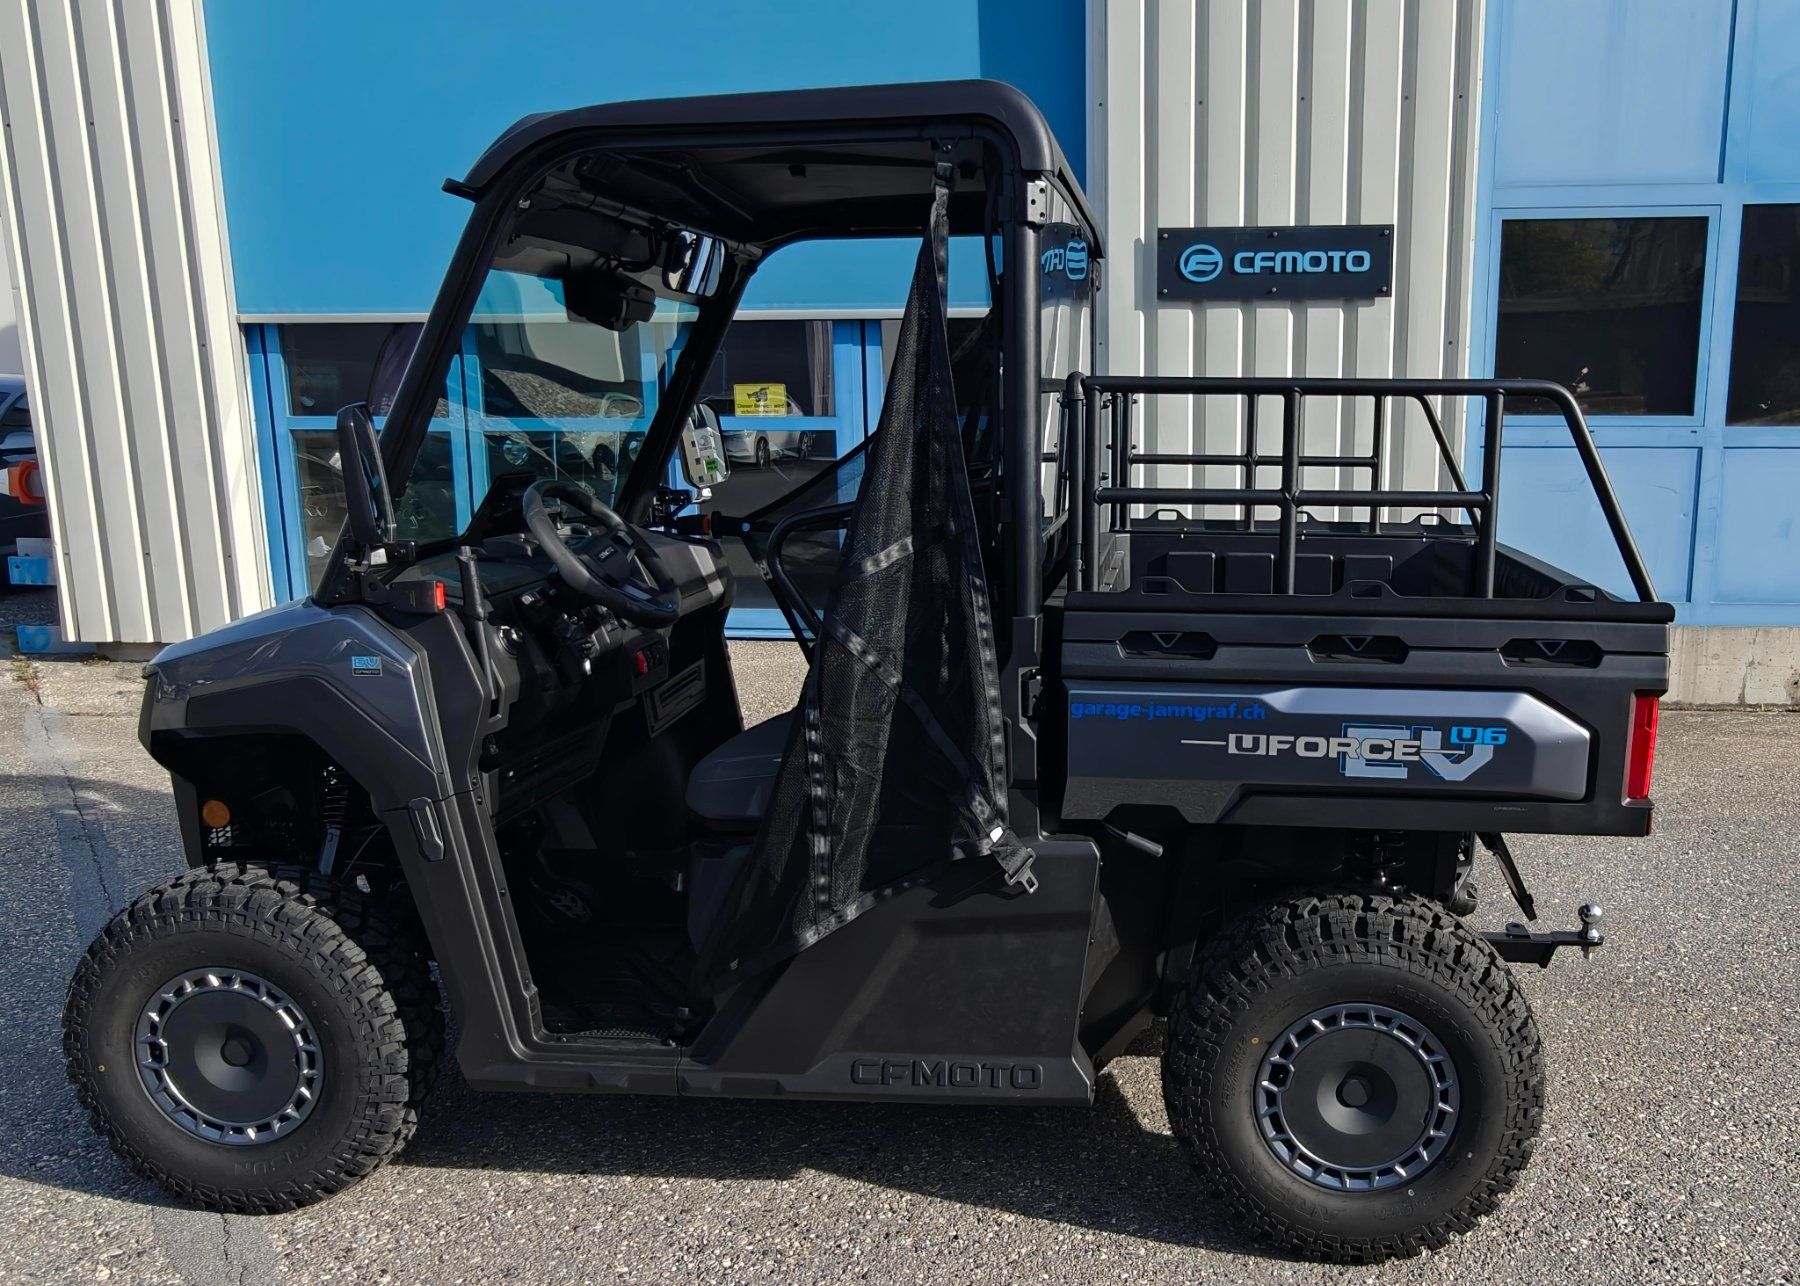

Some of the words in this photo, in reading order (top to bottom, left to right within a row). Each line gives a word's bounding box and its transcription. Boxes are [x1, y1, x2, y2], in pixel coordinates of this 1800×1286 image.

[1233, 250, 1371, 274] CFMOTO
[1071, 701, 1266, 722] garage-janngraf.ch
[1228, 733, 1421, 761] UFORCE
[1450, 726, 1508, 746] U6
[851, 1057, 1044, 1090] CFMOTO
